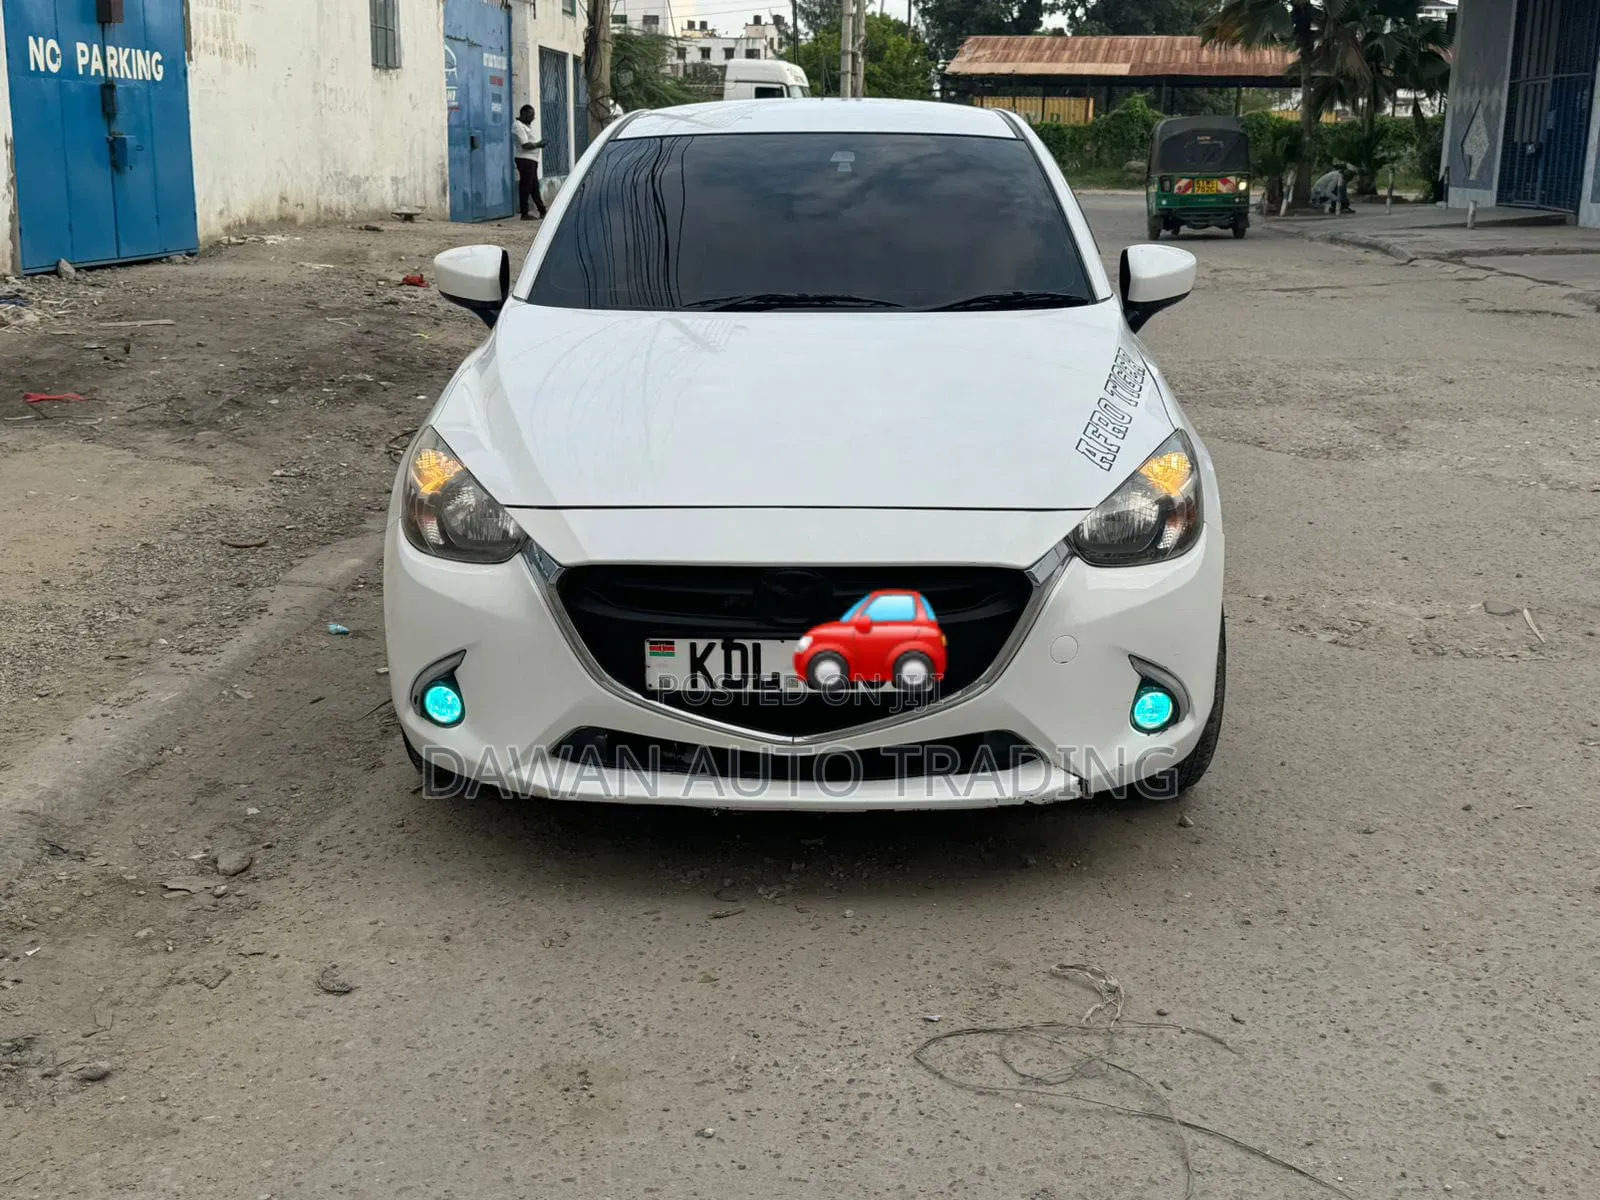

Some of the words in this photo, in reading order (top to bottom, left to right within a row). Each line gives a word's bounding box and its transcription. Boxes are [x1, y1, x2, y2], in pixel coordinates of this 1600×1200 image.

[28, 36, 62, 73] NO
[76, 42, 164, 81] PARKING
[1075, 397, 1132, 472] AFRO
[1104, 346, 1145, 407] TIGER
[689, 641, 781, 691] KDL
